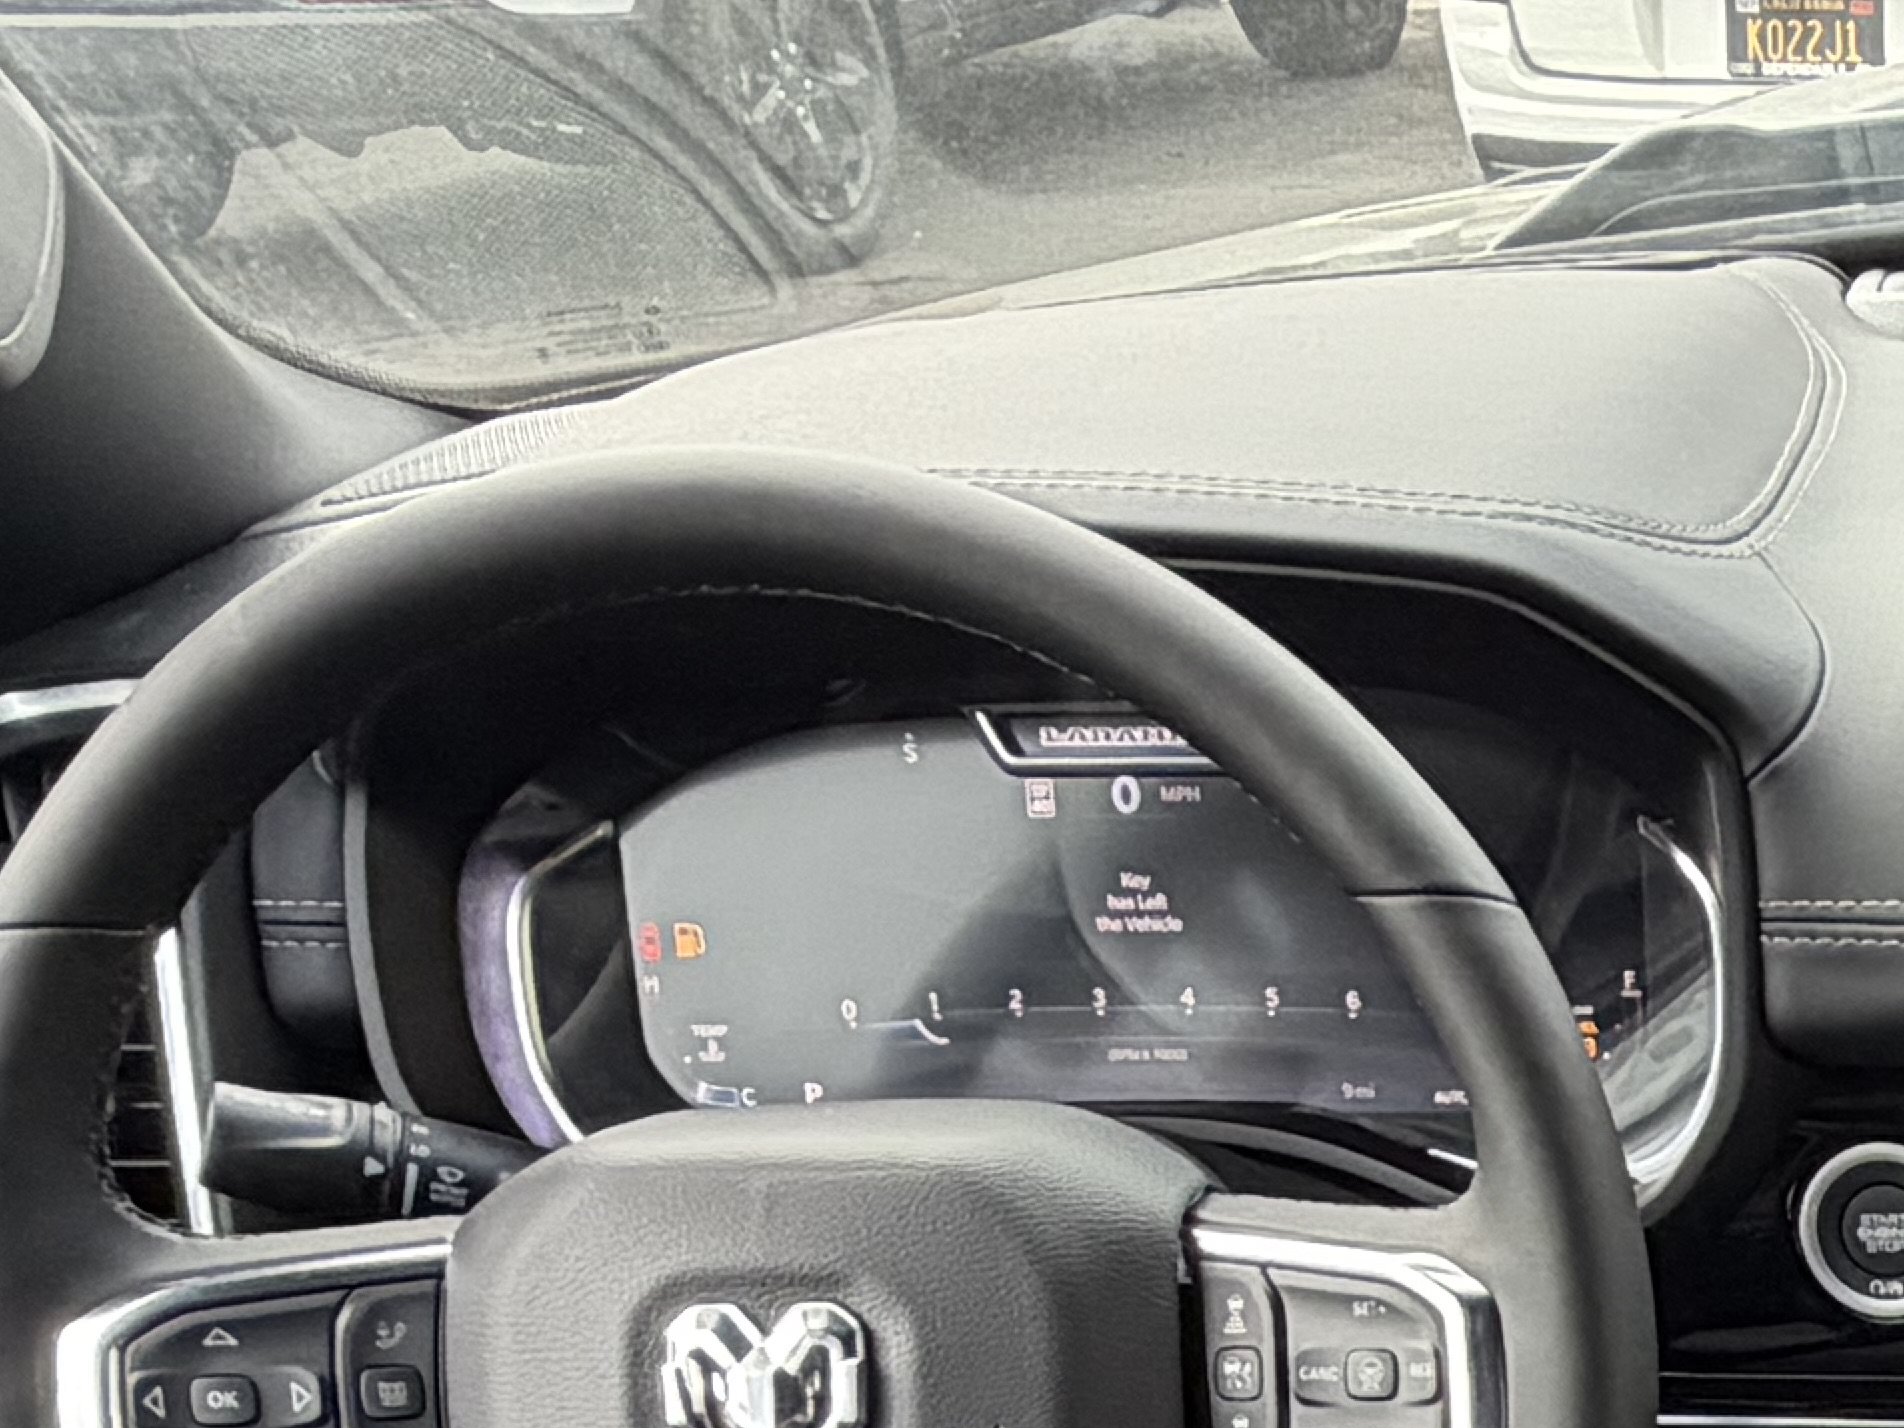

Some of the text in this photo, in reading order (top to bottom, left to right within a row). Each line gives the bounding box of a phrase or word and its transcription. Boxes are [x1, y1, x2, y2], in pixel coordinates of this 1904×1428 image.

[902, 742, 919, 764] S
[1110, 774, 1142, 815] 0
[1160, 785, 1201, 802] MPH
[1120, 871, 1152, 891] Key
[1106, 892, 1169, 910] has Left
[1124, 915, 1184, 932] Vehicle
[841, 999, 858, 1021] 0
[1009, 988, 1023, 1010] 2
[1092, 986, 1107, 1008] 3
[1180, 986, 1196, 1006] 4
[1265, 986, 1280, 1008] 5
[1345, 989, 1362, 1010] 6
[740, 1086, 758, 1108] C
[803, 1082, 824, 1105] P
[206, 1389, 241, 1410] OK
